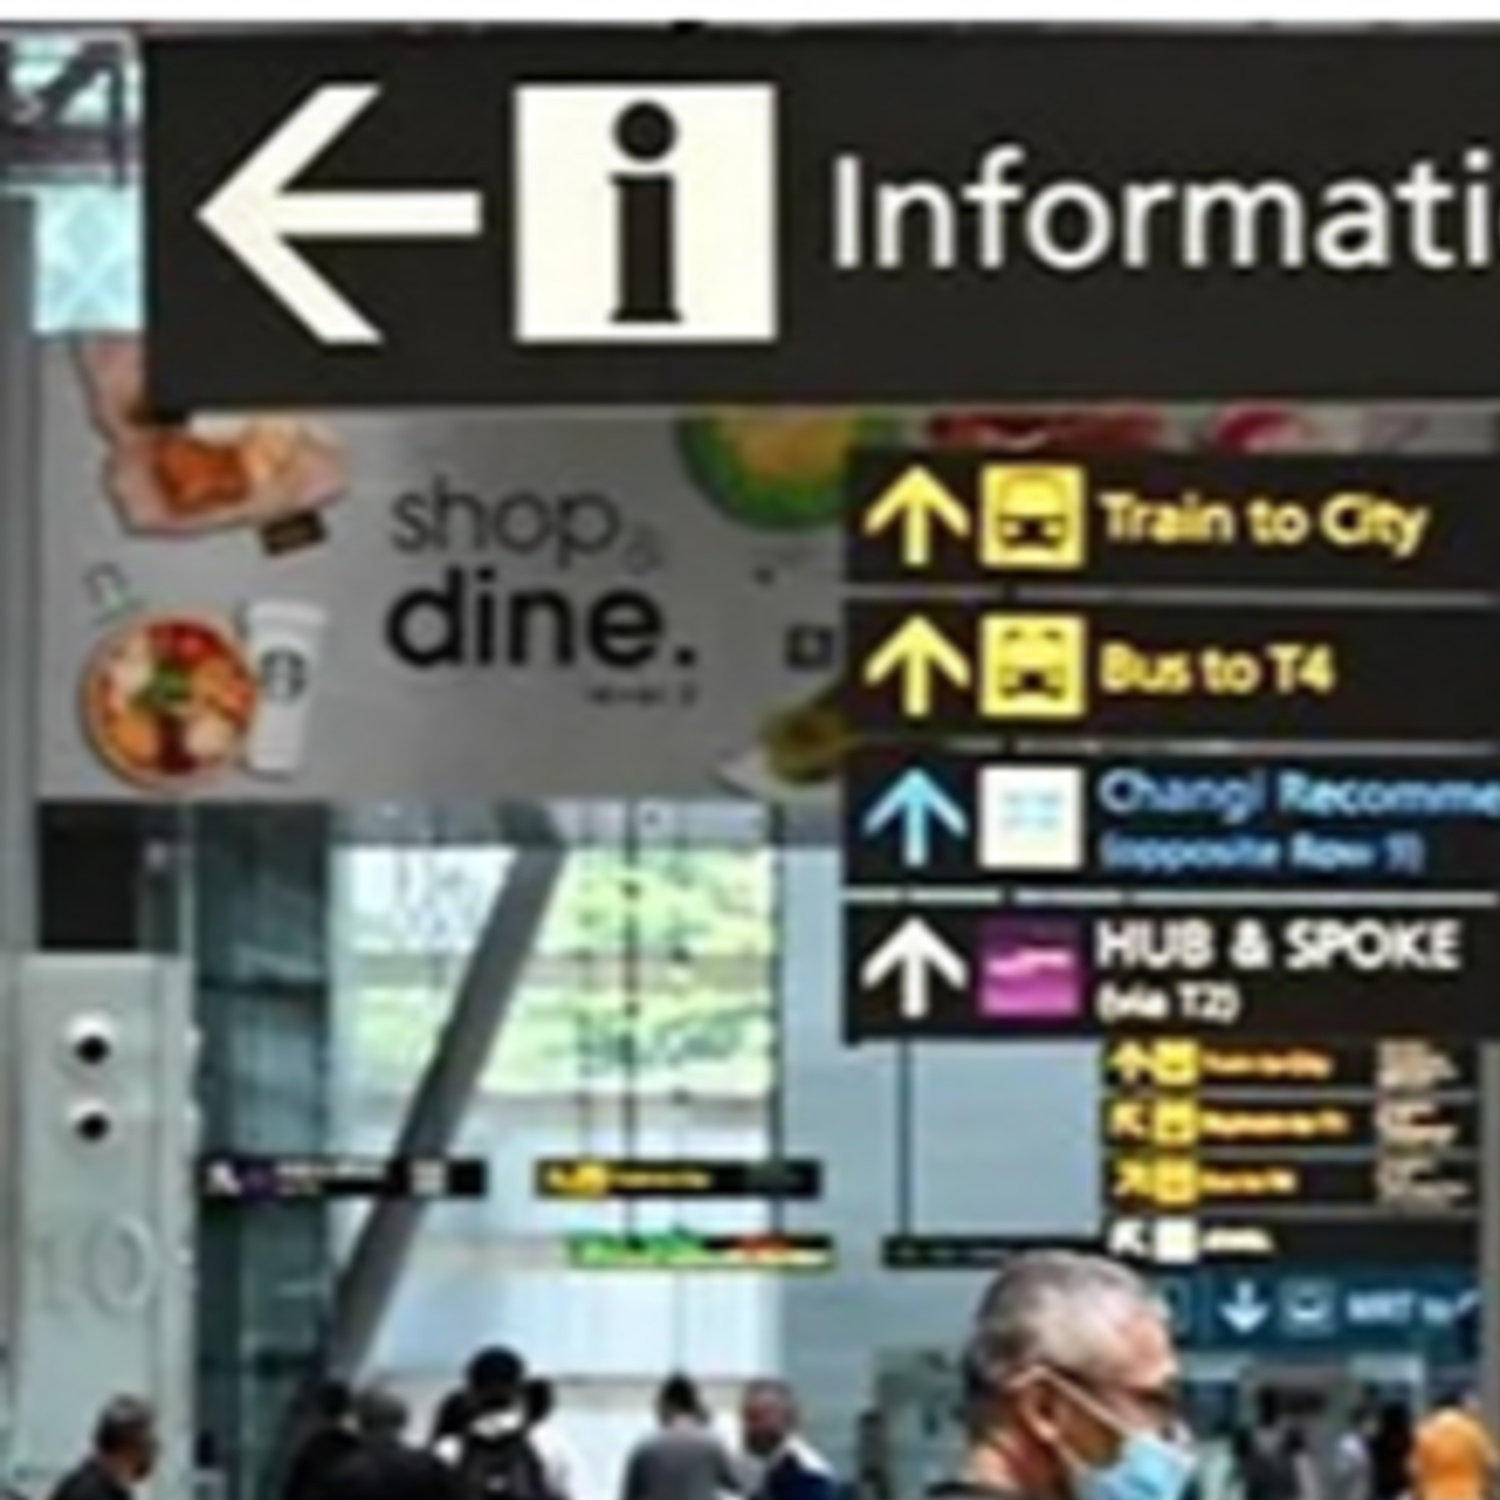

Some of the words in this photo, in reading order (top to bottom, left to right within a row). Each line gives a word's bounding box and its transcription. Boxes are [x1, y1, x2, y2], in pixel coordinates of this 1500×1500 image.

[389, 474, 621, 570] shop
[1098, 491, 1235, 544] Train
[1246, 498, 1310, 544] to
[1319, 493, 1429, 557] City
[386, 563, 697, 670] dine.
[1098, 642, 1193, 694] Bus
[1200, 648, 1261, 694] to
[1267, 643, 1336, 693] T4
[1096, 918, 1215, 970] HUB
[1229, 918, 1272, 970] &
[1284, 918, 1461, 970] SPOKE
